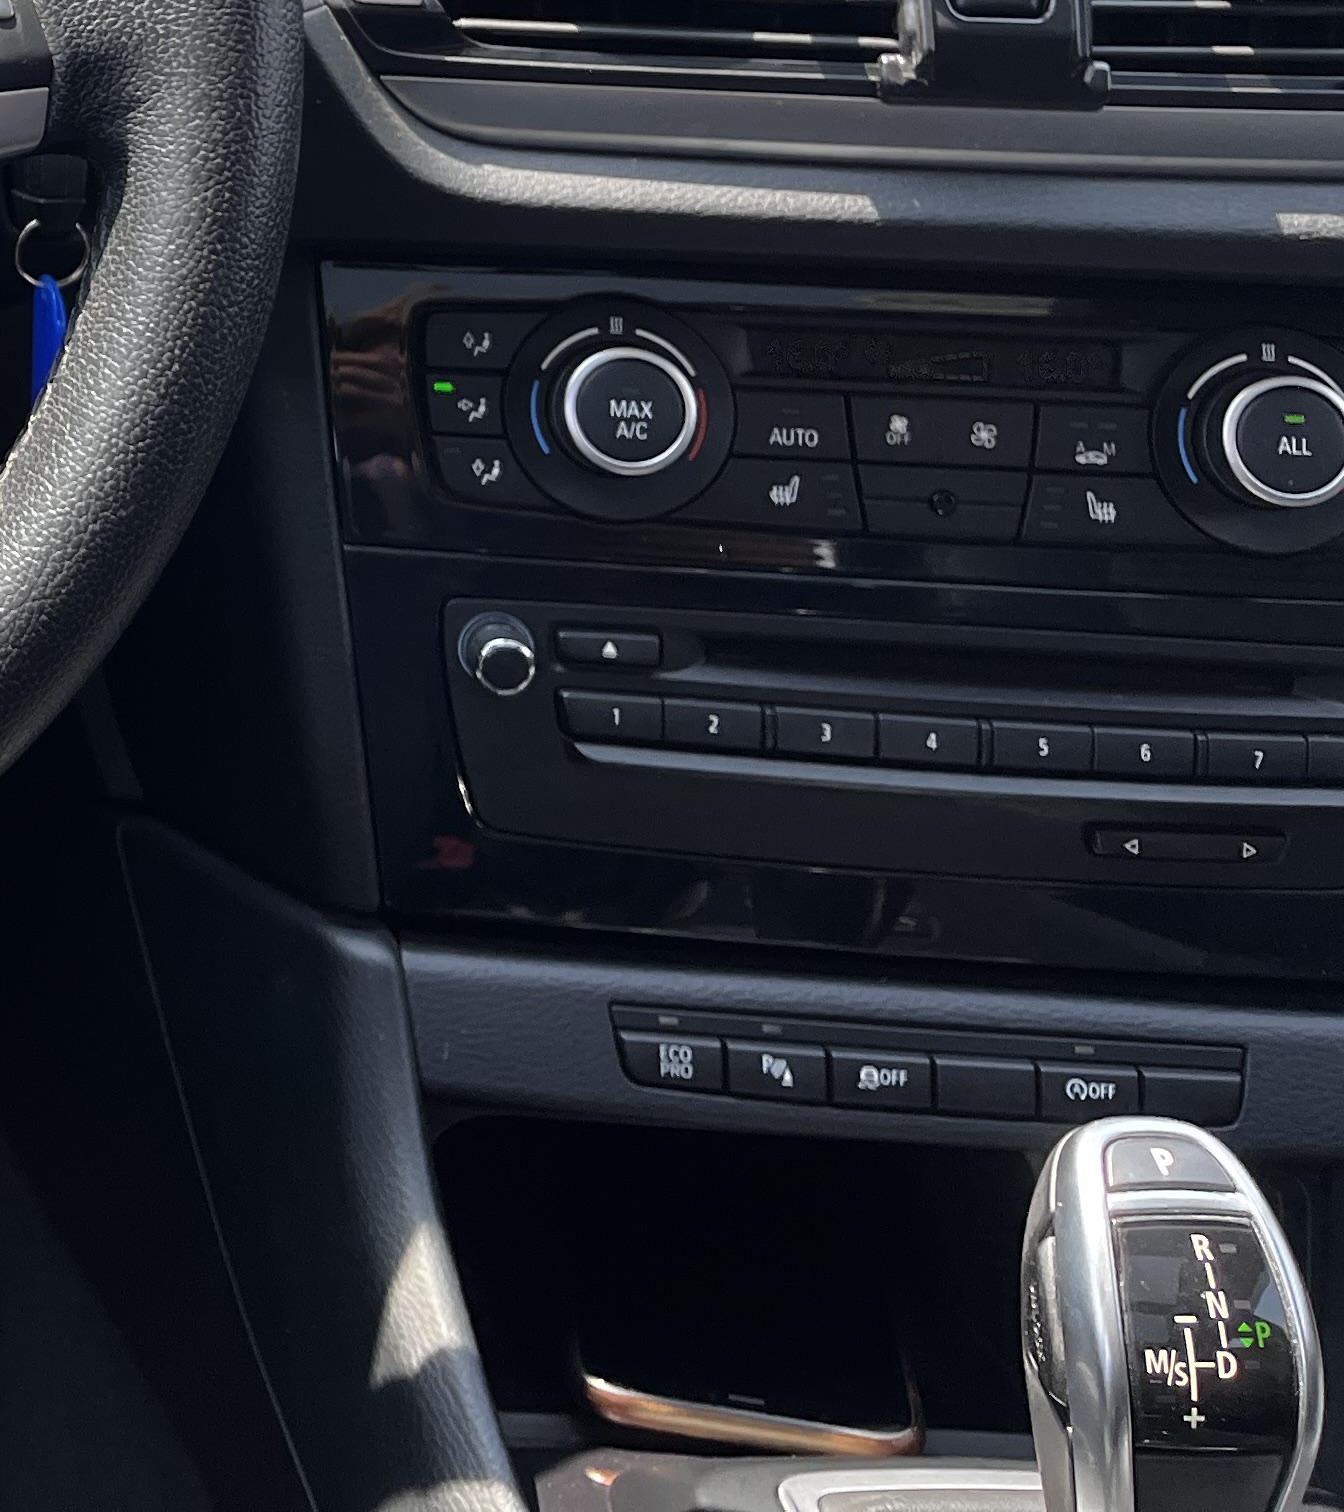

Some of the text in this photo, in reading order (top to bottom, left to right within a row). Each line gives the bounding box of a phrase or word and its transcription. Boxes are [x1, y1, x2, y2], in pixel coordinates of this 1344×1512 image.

[609, 400, 652, 420] MAX
[615, 422, 648, 441] A/C
[769, 428, 818, 448] AUTO
[1278, 436, 1312, 457] ALL
[612, 708, 1264, 770] 1 2 3 4 5 6 7
[659, 1044, 692, 1063] ECO
[660, 1062, 693, 1079] PRO
[880, 1068, 908, 1087] OFF
[1088, 1082, 1116, 1100] OFF
[1150, 1147, 1174, 1176] P
[1190, 1234, 1215, 1261] R
[1205, 1291, 1228, 1319] N
[1255, 1321, 1271, 1348] P
[1216, 1351, 1237, 1379] D
